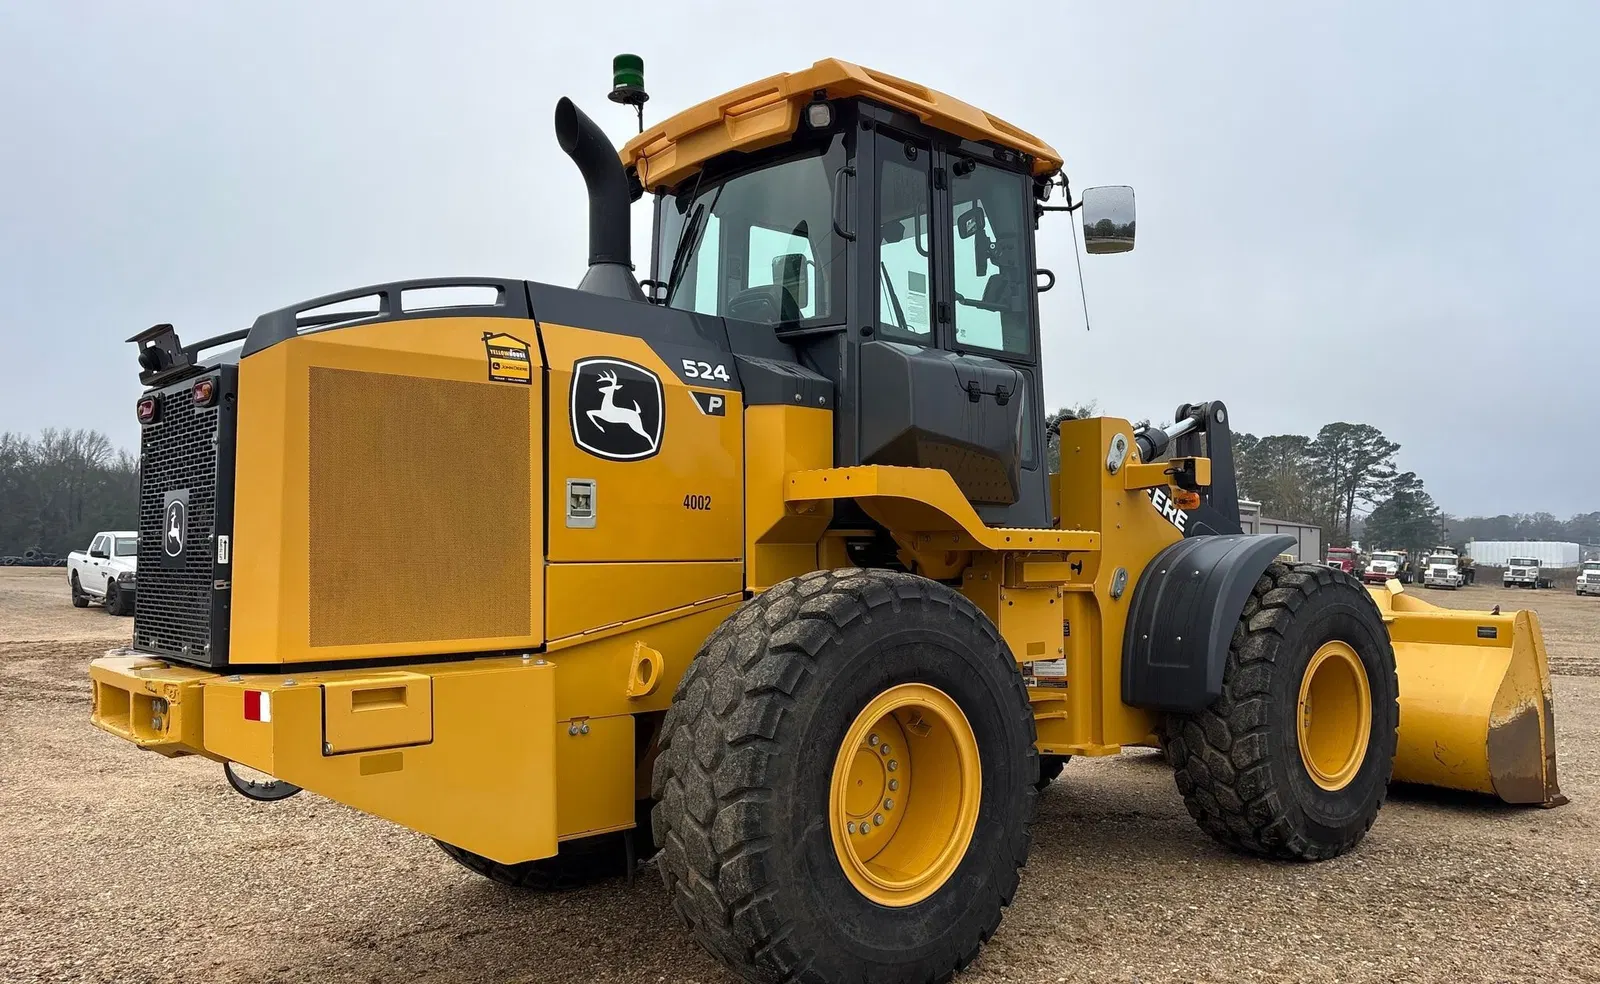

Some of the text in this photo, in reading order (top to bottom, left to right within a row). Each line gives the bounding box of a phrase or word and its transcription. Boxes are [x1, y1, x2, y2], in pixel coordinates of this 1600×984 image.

[682, 359, 730, 382] 524
[708, 396, 723, 413] P
[683, 494, 711, 510] 4002
[1146, 487, 1188, 532] ERE
